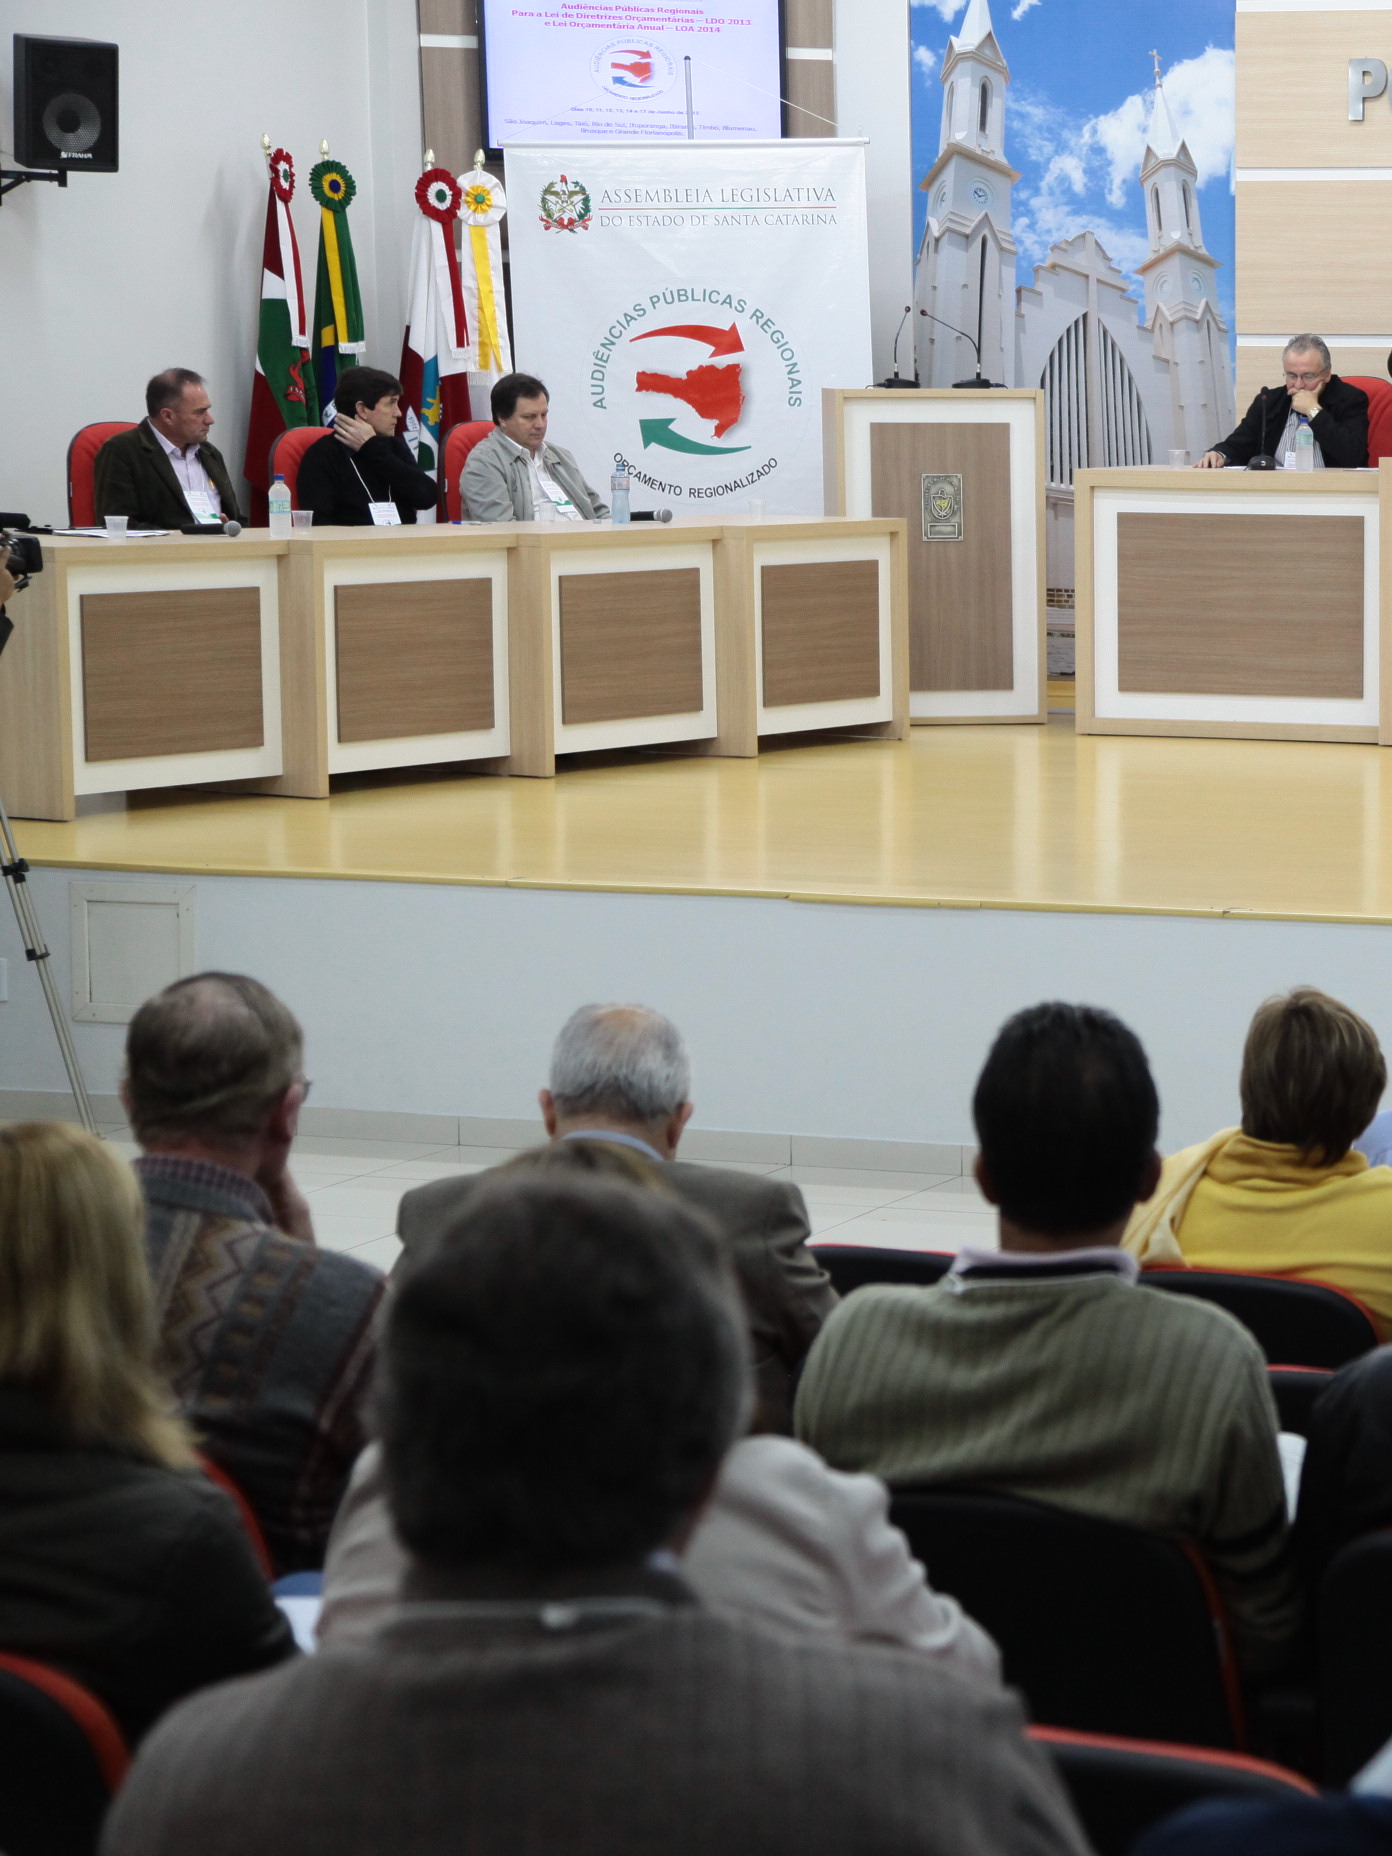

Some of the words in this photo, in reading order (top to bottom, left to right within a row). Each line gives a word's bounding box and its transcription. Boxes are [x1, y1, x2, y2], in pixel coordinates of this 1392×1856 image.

[560, 3, 614, 12] Audiências
[615, 5, 655, 13] Públicas
[657, 7, 704, 15] Regionais
[576, 12, 623, 20] Diretrizes
[705, 17, 725, 25] LDO
[727, 18, 752, 26] 2013
[637, 23, 664, 31] Anual
[600, 188, 714, 203] ASSEMBLEIA
[720, 187, 836, 202] LEGISLATIVA
[600, 215, 622, 227] DO
[628, 214, 685, 227] ESTADO
[690, 214, 708, 226] DE
[714, 214, 760, 226] SANTA
[764, 213, 837, 226] CATARINA
[590, 303, 647, 410] AUDIÊNCIAS
[649, 287, 747, 313] PÚBLICAS
[749, 308, 802, 408] REGIONAIS
[688, 457, 778, 499] REGIONALIZADO
